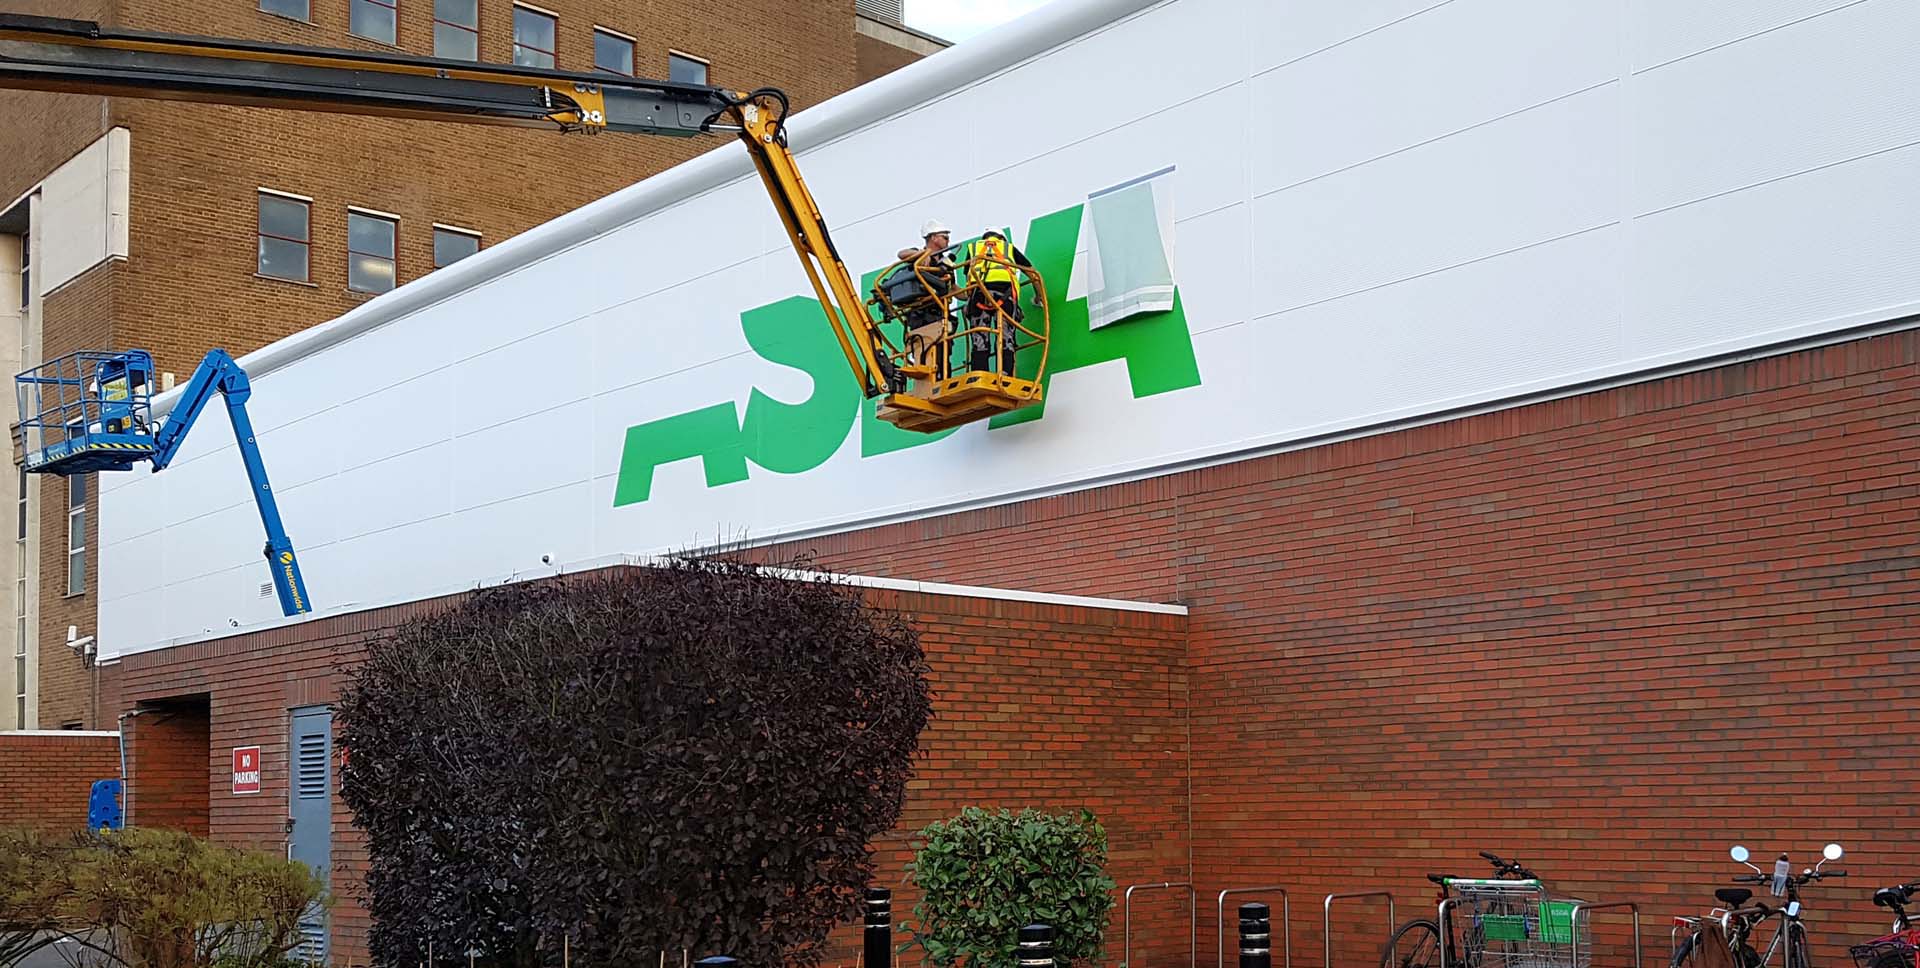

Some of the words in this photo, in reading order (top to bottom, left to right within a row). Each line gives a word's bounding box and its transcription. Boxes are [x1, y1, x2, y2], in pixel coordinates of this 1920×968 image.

[284, 564, 303, 609] Nationwide
[242, 754, 251, 768] NO
[234, 771, 258, 784] PARKING
